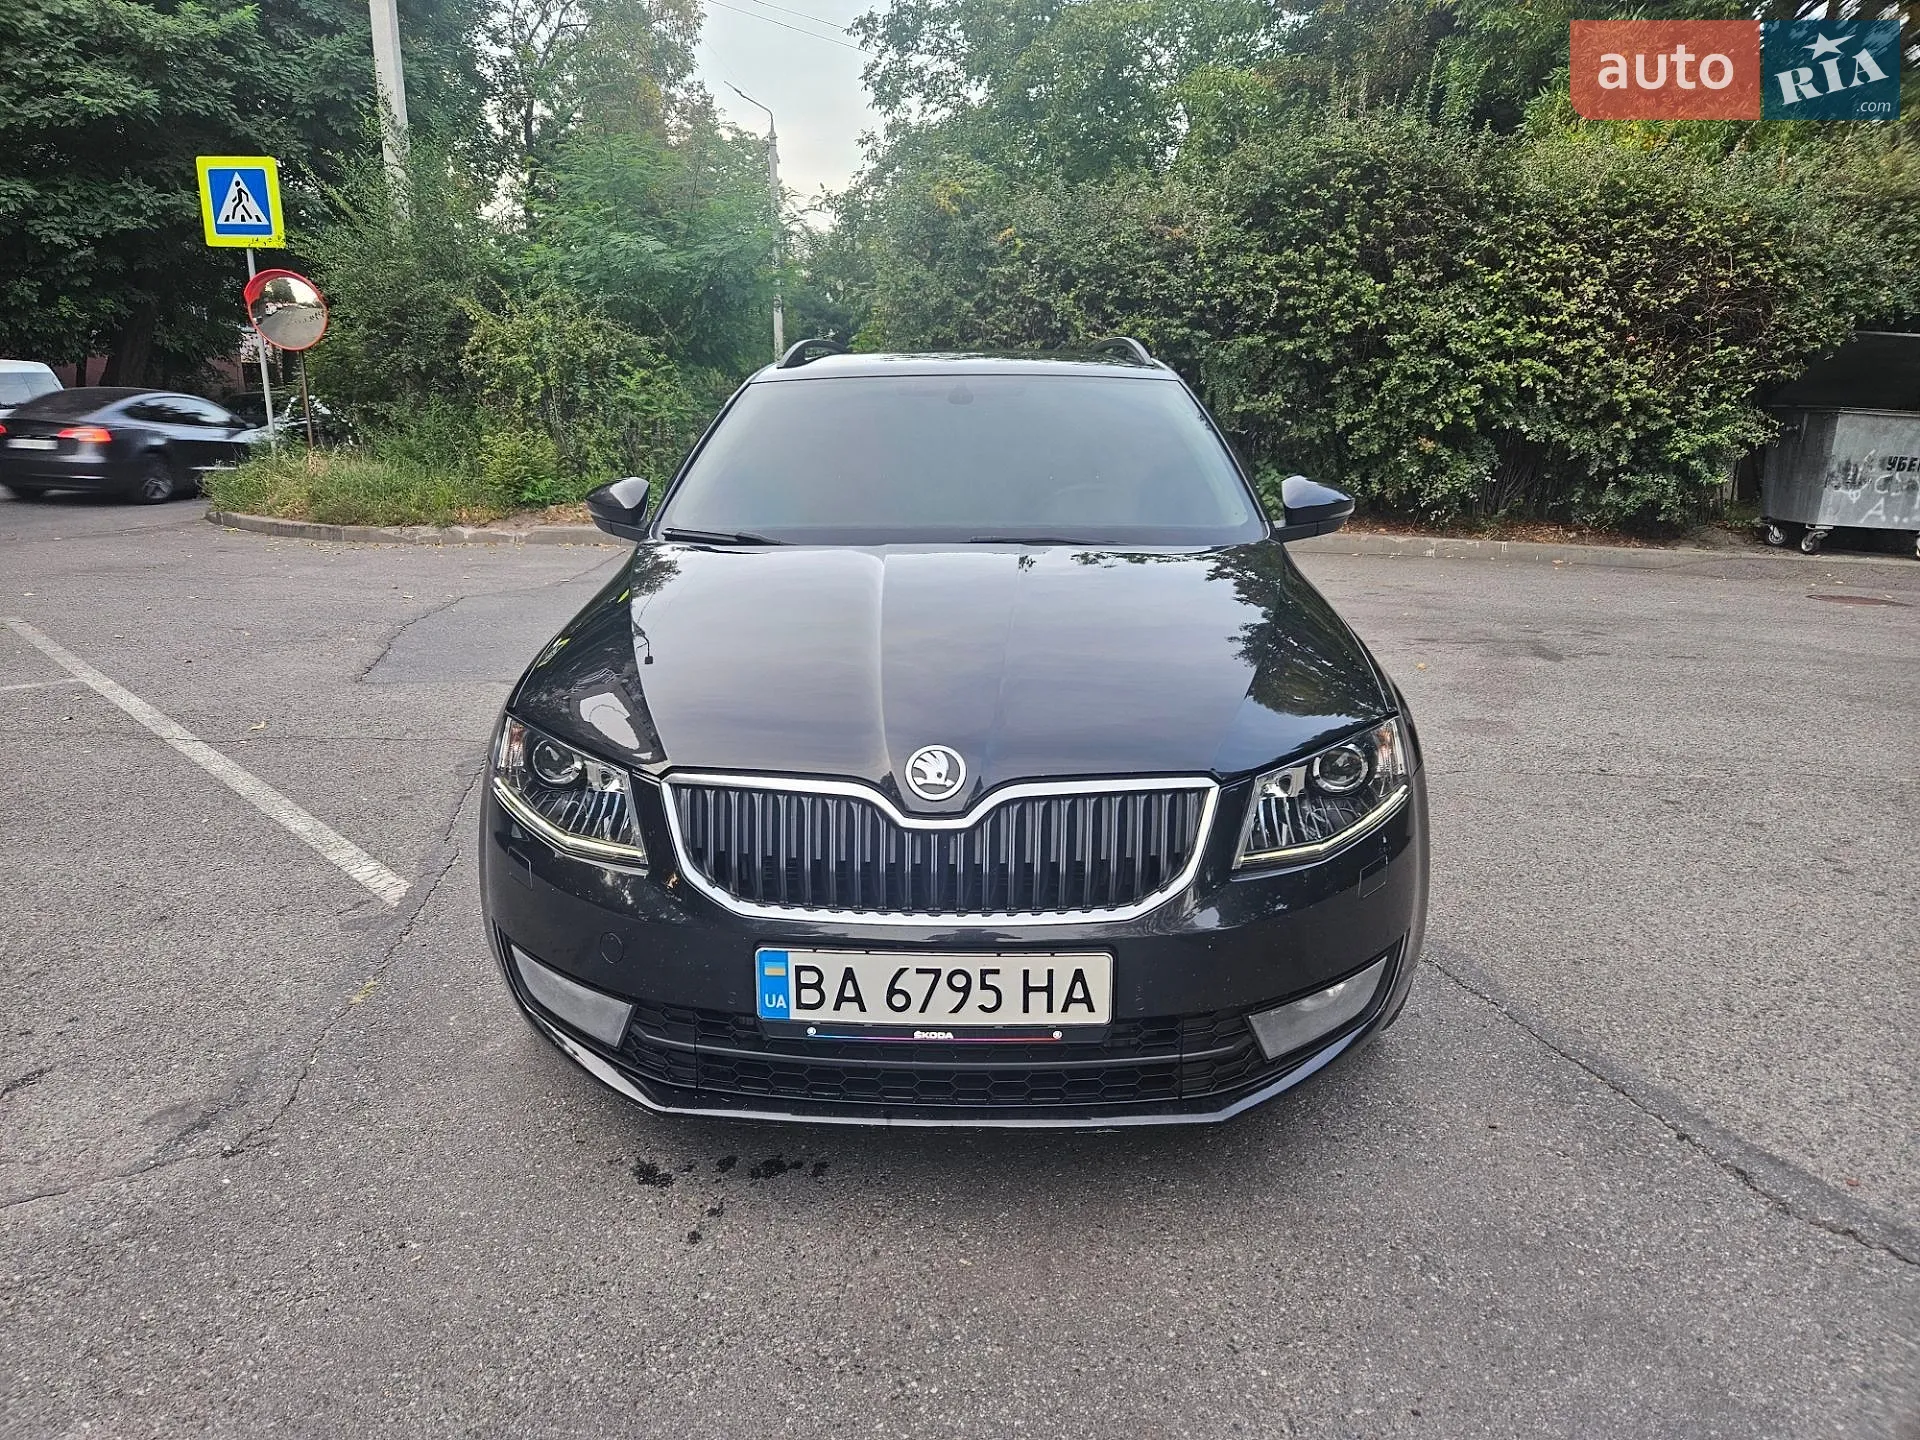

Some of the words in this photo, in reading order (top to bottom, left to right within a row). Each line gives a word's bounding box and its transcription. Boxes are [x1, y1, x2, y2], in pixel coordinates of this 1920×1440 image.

[764, 993, 787, 1009] UA
[795, 965, 867, 1012] BA
[886, 967, 1002, 1014] 6795
[1022, 968, 1096, 1014] HA
